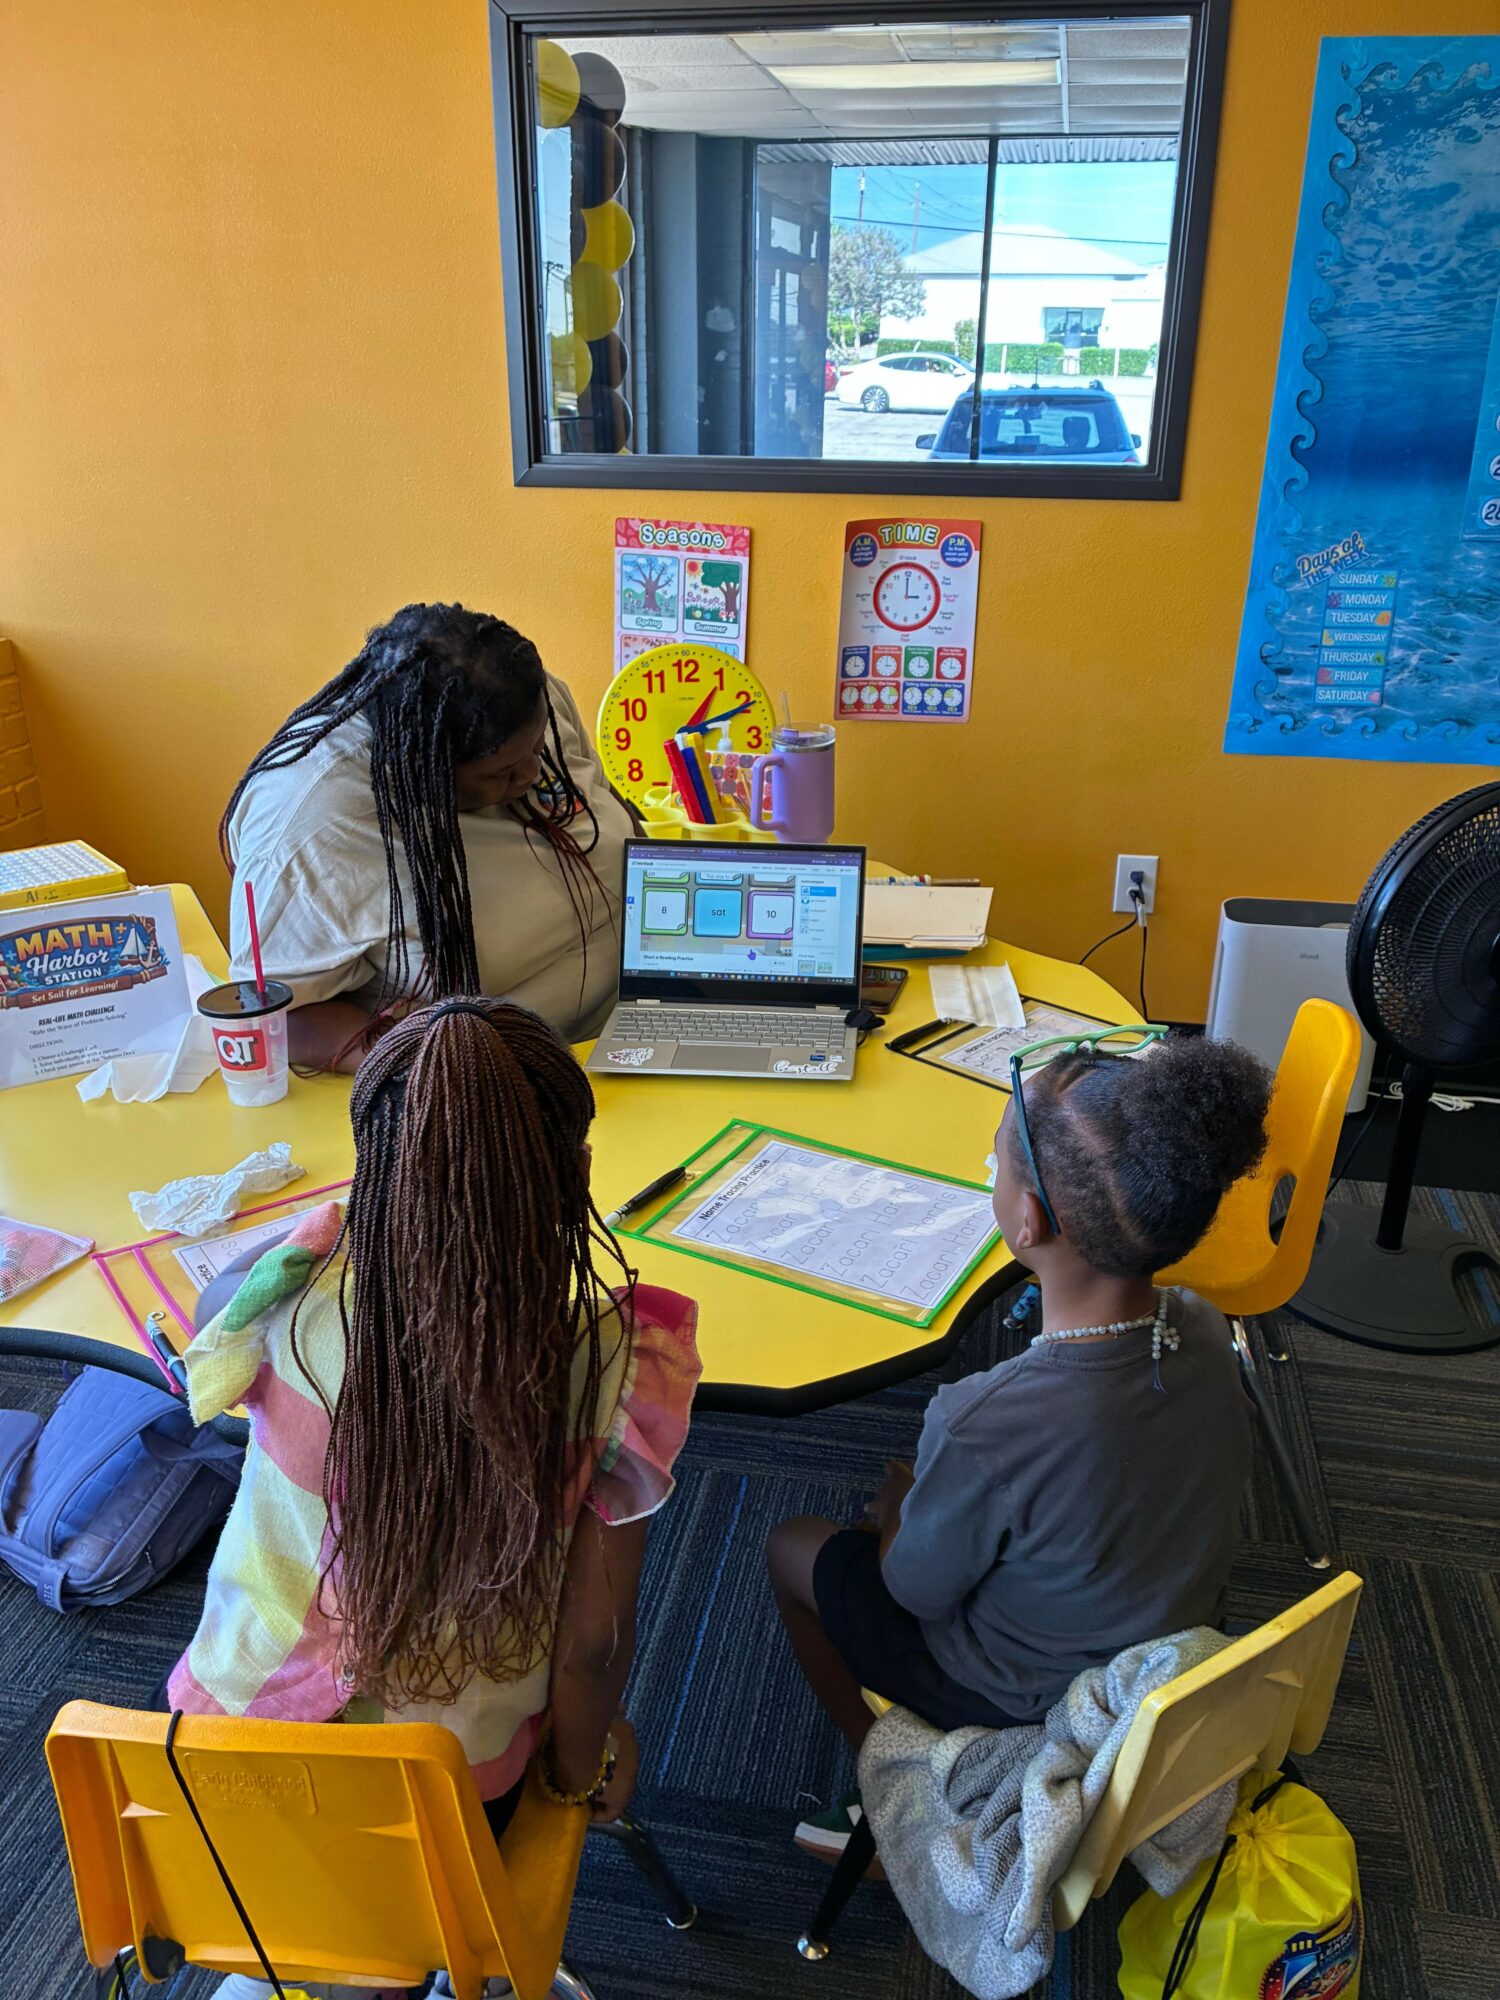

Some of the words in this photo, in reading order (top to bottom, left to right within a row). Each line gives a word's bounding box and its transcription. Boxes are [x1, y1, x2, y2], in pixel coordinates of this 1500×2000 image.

[641, 524, 724, 547] Seasons
[880, 524, 938, 544] TIME
[949, 538, 967, 546] P.M.
[1297, 546, 1340, 575] Days
[1342, 532, 1364, 553] of
[1305, 568, 1330, 586] THE
[1331, 550, 1369, 573] WEEK
[1338, 574, 1379, 584] SUNDAY
[1345, 594, 1388, 605] MONDAY
[636, 617, 662, 628] Spring
[695, 623, 728, 633] Summer
[1331, 612, 1376, 623] TUESDAY
[1334, 632, 1387, 642] WEDNESDAY
[1323, 652, 1374, 663] THURSDAY
[642, 670, 665, 693] 11
[672, 659, 700, 683] 12
[714, 668, 725, 691] 1
[1334, 671, 1369, 681] FRIDAY
[735, 691, 751, 714] 2
[1318, 690, 1368, 701] SATURDAY
[619, 698, 647, 722] 10
[615, 728, 631, 751] 9
[747, 726, 763, 749] 3
[628, 759, 644, 782] 8
[661, 905, 667, 914] 8
[711, 907, 726, 917] sat
[766, 910, 777, 919] 10
[15, 923, 113, 961] MATH
[26, 949, 110, 977] Harbor
[44, 967, 102, 985] STATION
[32, 993, 46, 1003] Set
[48, 989, 64, 999] Sail
[66, 988, 79, 998] for
[80, 980, 119, 995] Learning!
[38, 1013, 66, 1026] REAL-LIFE
[67, 1010, 83, 1020] MATH
[84, 1005, 115, 1017] CHALLENGE
[57, 1023, 72, 1031] Wave
[54, 1055, 80, 1065] individually
[61, 1048, 84, 1057] Challenge
[218, 1035, 256, 1066] QT
[699, 1200, 724, 1221] Name
[717, 1180, 747, 1204] Tracing
[740, 1159, 770, 1183] Practice
[705, 1197, 769, 1244] Zacari
[821, 1228, 881, 1277] Zacari
[865, 1182, 920, 1227] Harris
[781, 1216, 842, 1264] Zacari
[860, 1238, 919, 1289] Zacari
[904, 1191, 957, 1234] Harris
[900, 1248, 960, 1301] Zacari
[232, 1771, 306, 1793] Childhood
